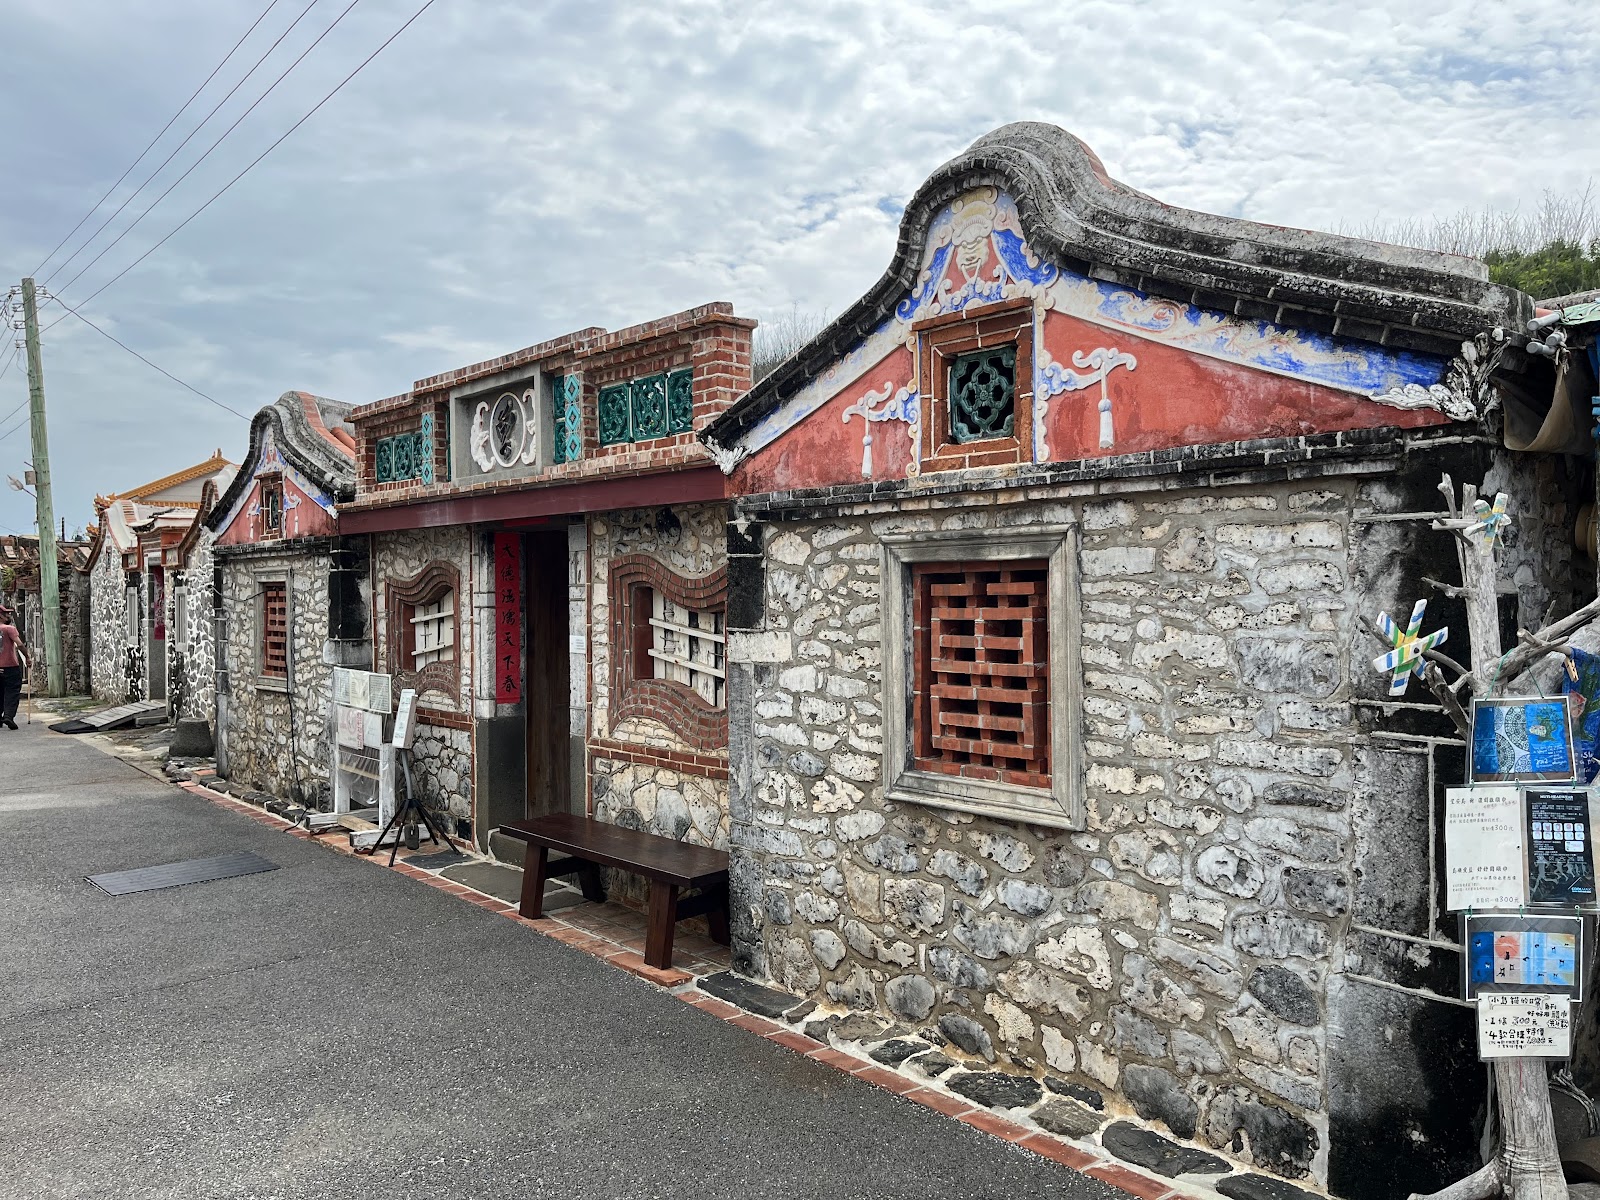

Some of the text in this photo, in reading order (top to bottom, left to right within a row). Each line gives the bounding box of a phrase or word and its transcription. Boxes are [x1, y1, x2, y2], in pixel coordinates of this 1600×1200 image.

[500, 543, 517, 693] 大德涵濡天下春
